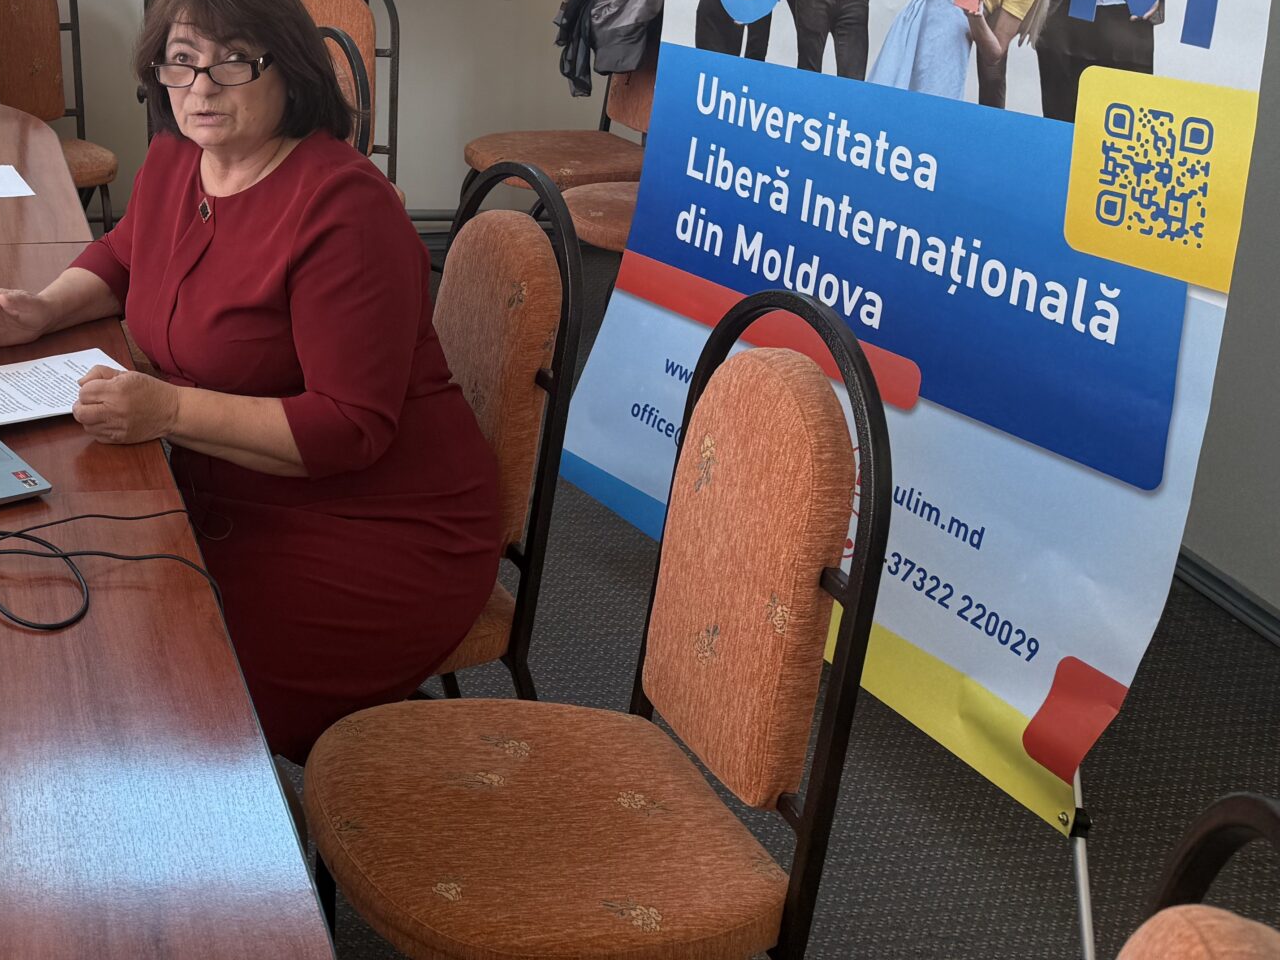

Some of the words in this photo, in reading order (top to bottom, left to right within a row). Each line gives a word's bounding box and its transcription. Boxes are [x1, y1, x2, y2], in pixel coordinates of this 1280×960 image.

[696, 72, 938, 192] Universitatea
[675, 203, 724, 257] din
[732, 223, 883, 330] Moldova
[686, 136, 790, 214] Liberă
[800, 178, 1121, 346] Internațională
[665, 358, 694, 384] ww
[893, 485, 986, 551] ulim.md
[884, 551, 954, 610] 37322
[956, 594, 1040, 662] 220029
